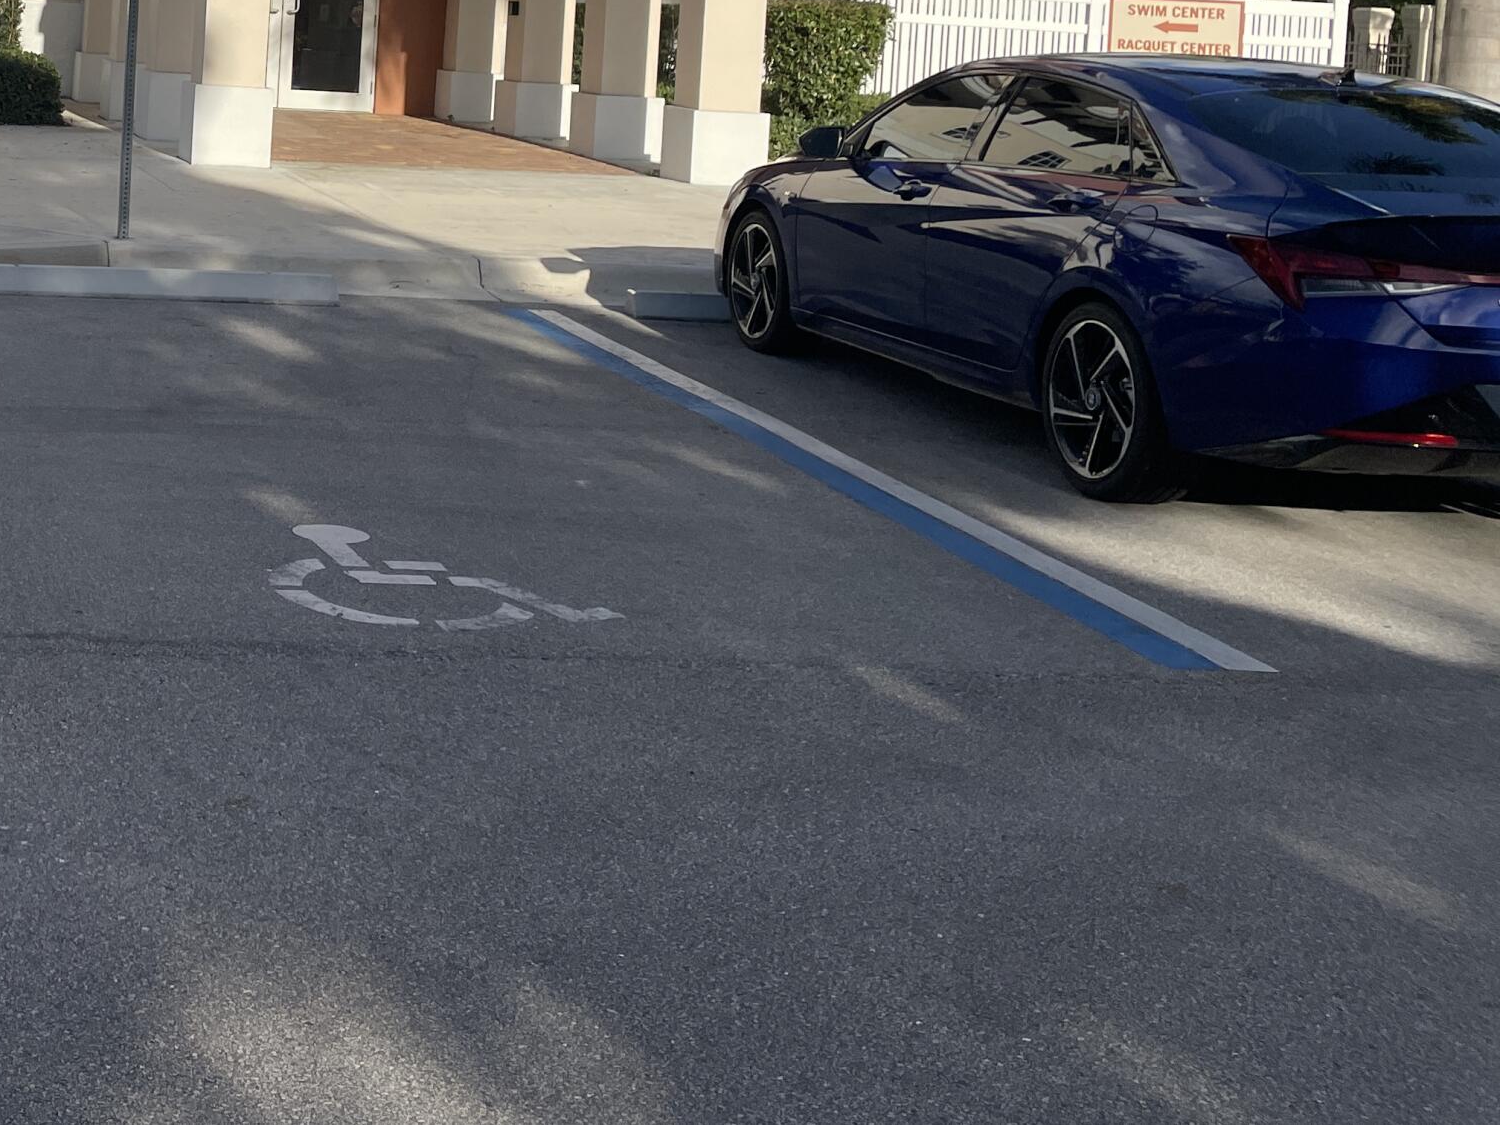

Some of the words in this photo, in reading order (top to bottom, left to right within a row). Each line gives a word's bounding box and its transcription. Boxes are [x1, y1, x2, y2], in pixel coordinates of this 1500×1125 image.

[1127, 4, 1167, 17] SWIM
[1172, 6, 1225, 20] CENTER
[1117, 38, 1177, 52] RACQUET
[1181, 42, 1231, 56] CENTER
